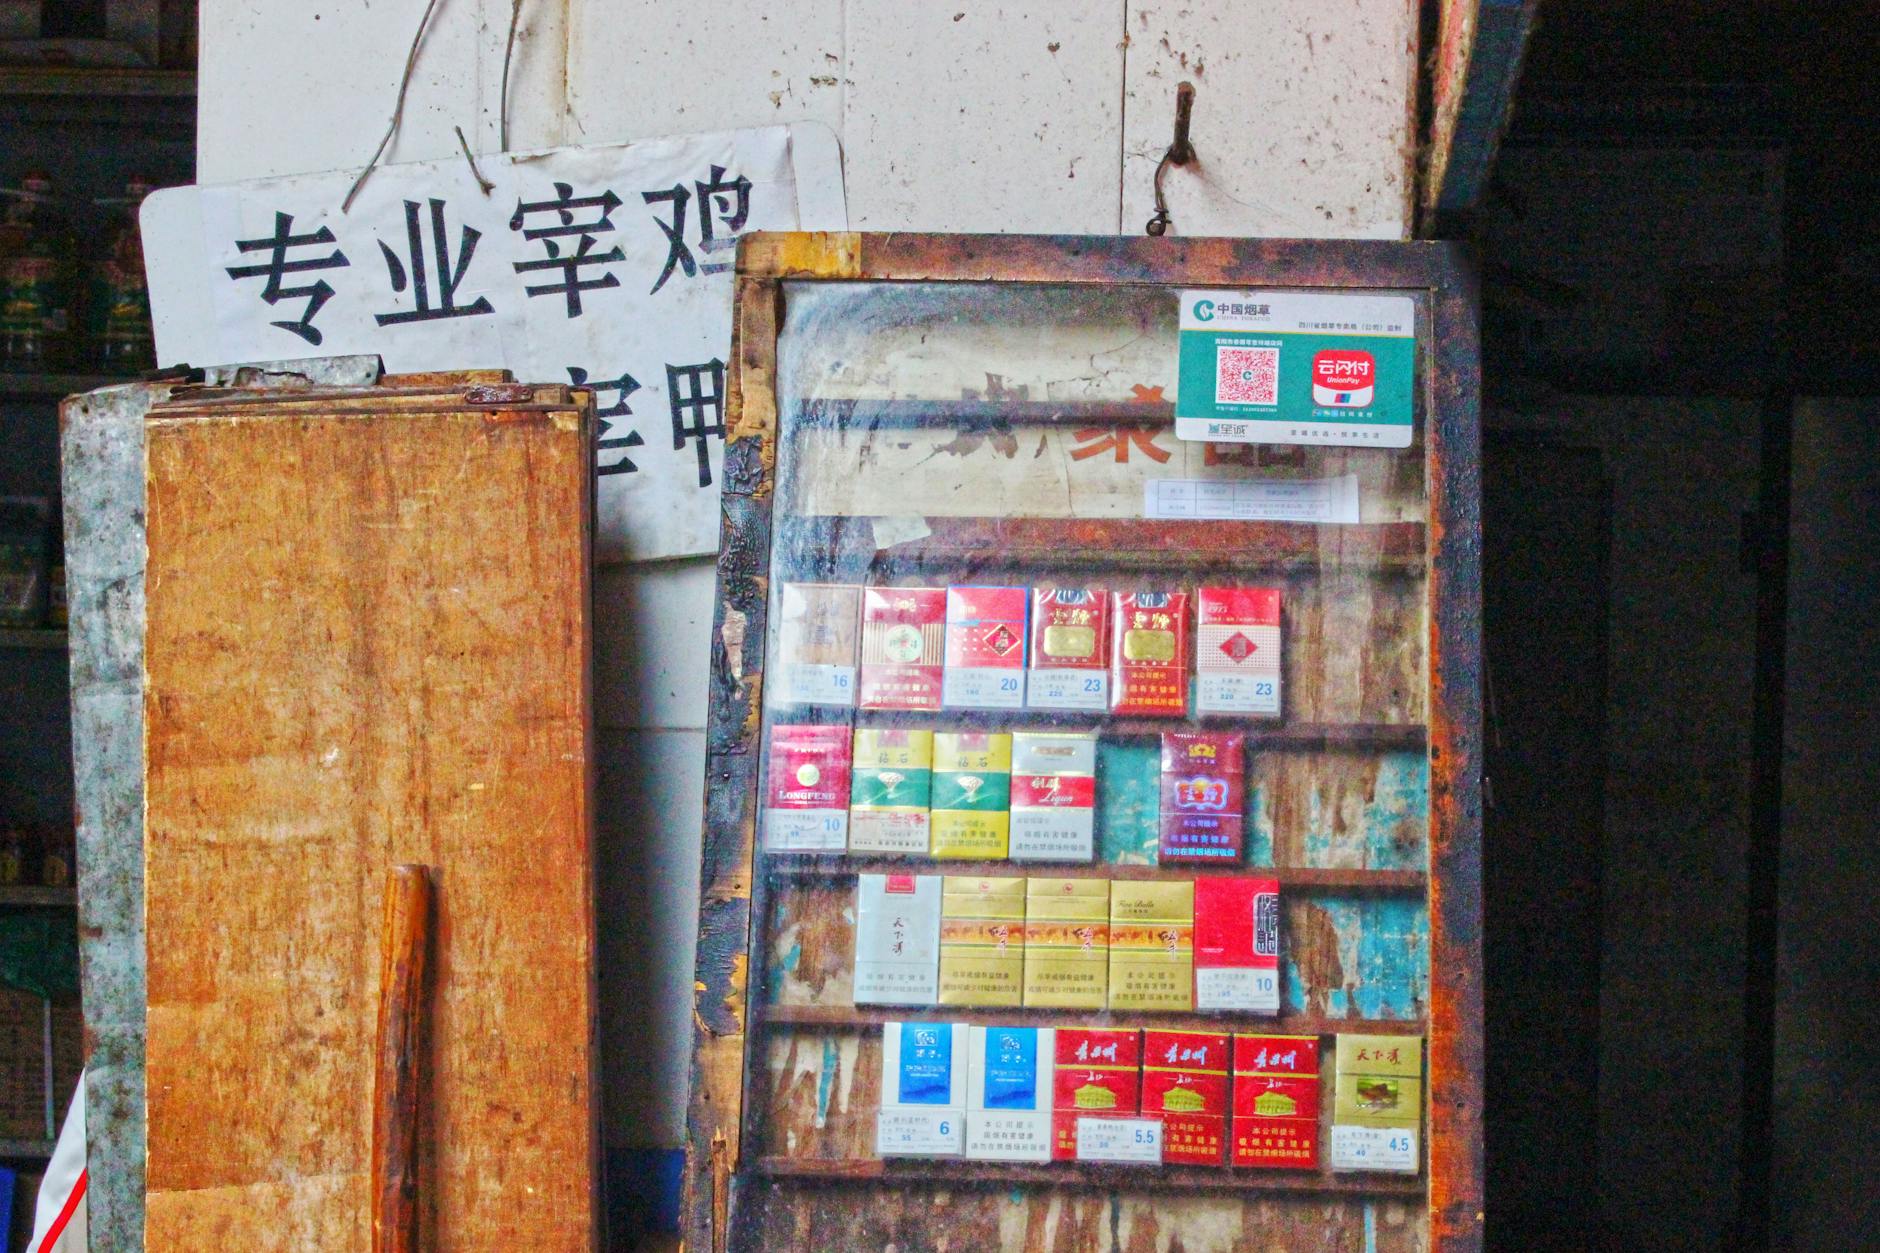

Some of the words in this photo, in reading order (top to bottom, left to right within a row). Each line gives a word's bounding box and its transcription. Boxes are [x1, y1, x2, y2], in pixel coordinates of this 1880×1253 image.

[225, 164, 753, 345] 专业宰鸡
[1217, 303, 1271, 316] 中国烟草
[1318, 360, 1370, 375] 云闪付
[1327, 377, 1360, 385] UnionPay
[833, 674, 848, 688] 16
[1000, 678, 1018, 691] 20
[1084, 679, 1101, 692] 23
[1256, 683, 1273, 696] 23
[823, 817, 841, 832] 10
[1256, 978, 1273, 992] 10
[939, 1121, 951, 1135] 6
[1134, 1129, 1155, 1144] 5.5
[1388, 1137, 1410, 1151] 4.5
